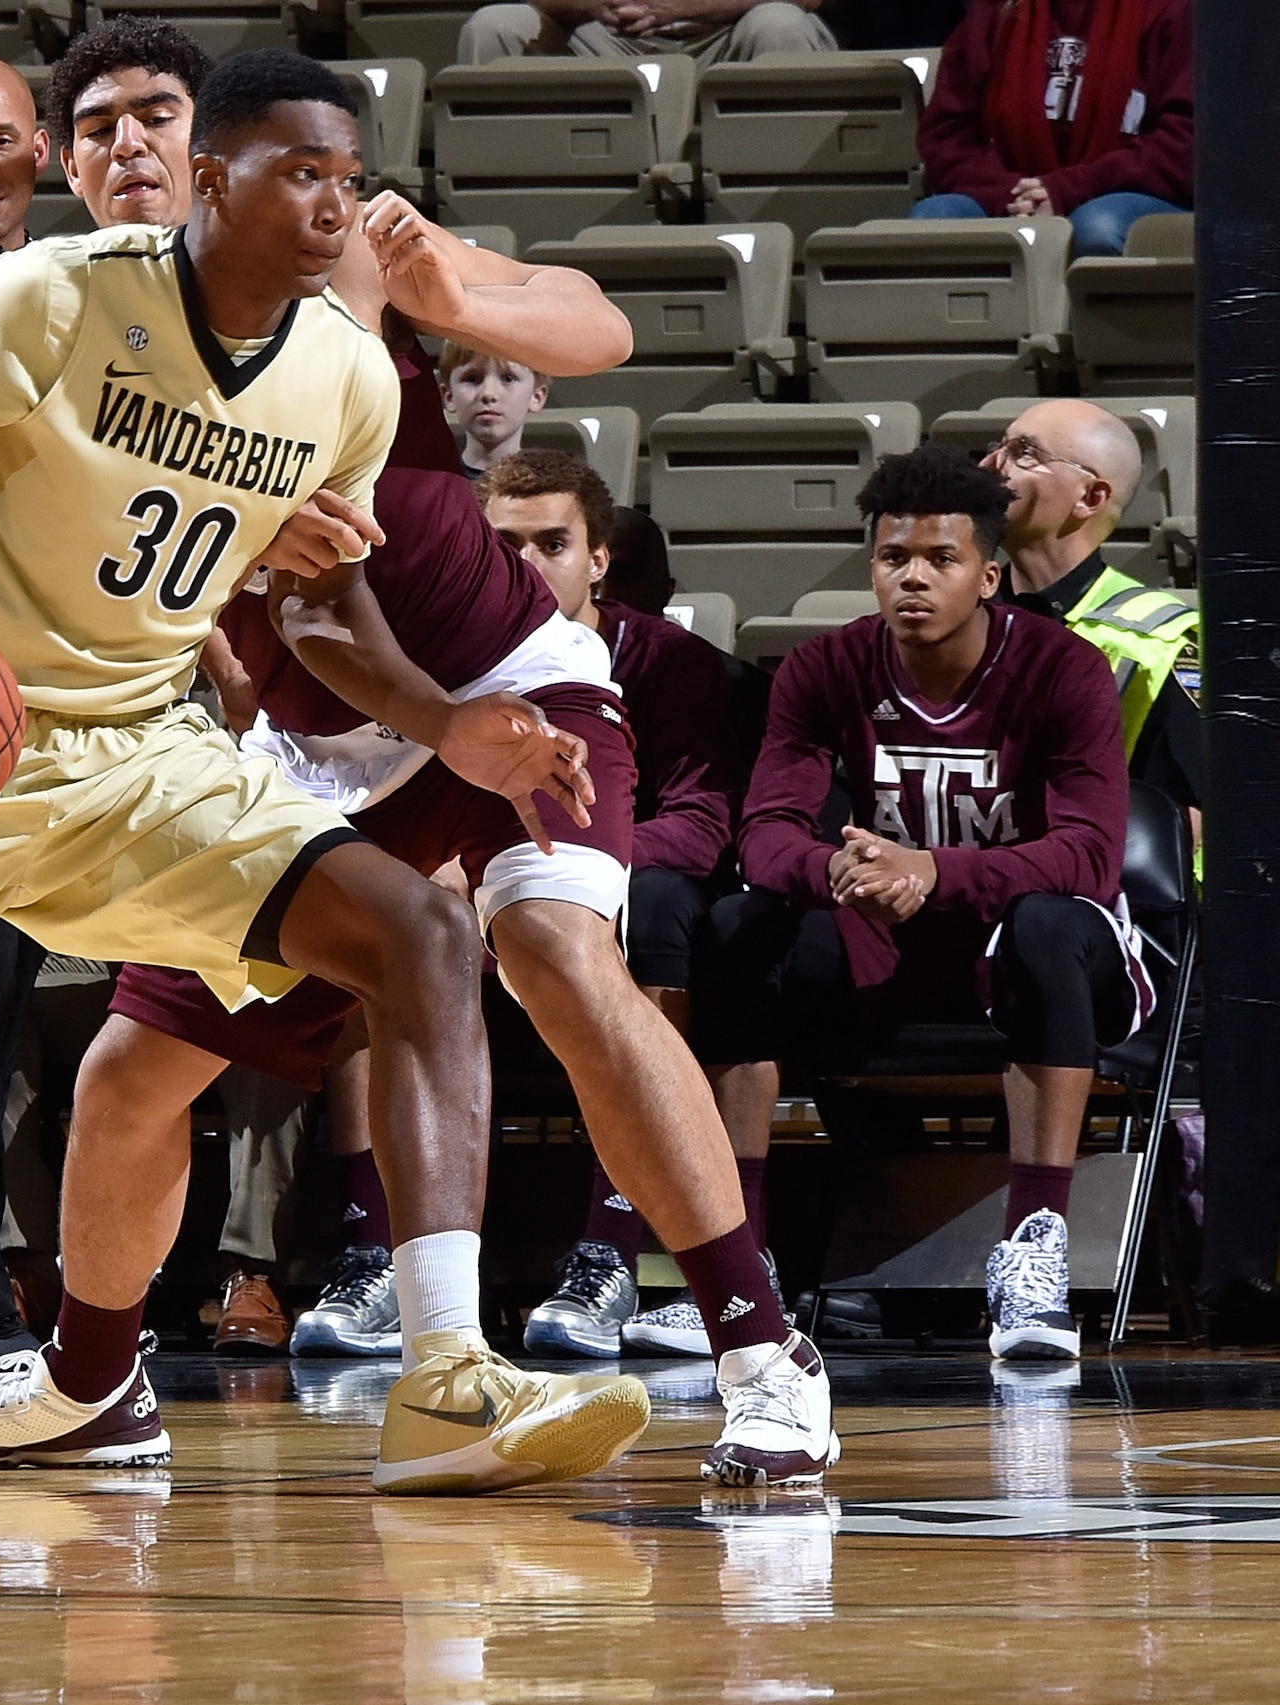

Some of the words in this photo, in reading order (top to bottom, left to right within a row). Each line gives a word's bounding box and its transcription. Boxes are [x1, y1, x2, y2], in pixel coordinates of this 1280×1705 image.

[127, 327, 148, 348] SEC
[91, 380, 317, 499] VANDERBILT
[94, 485, 241, 613] 30
[719, 1301, 756, 1323] adidas
